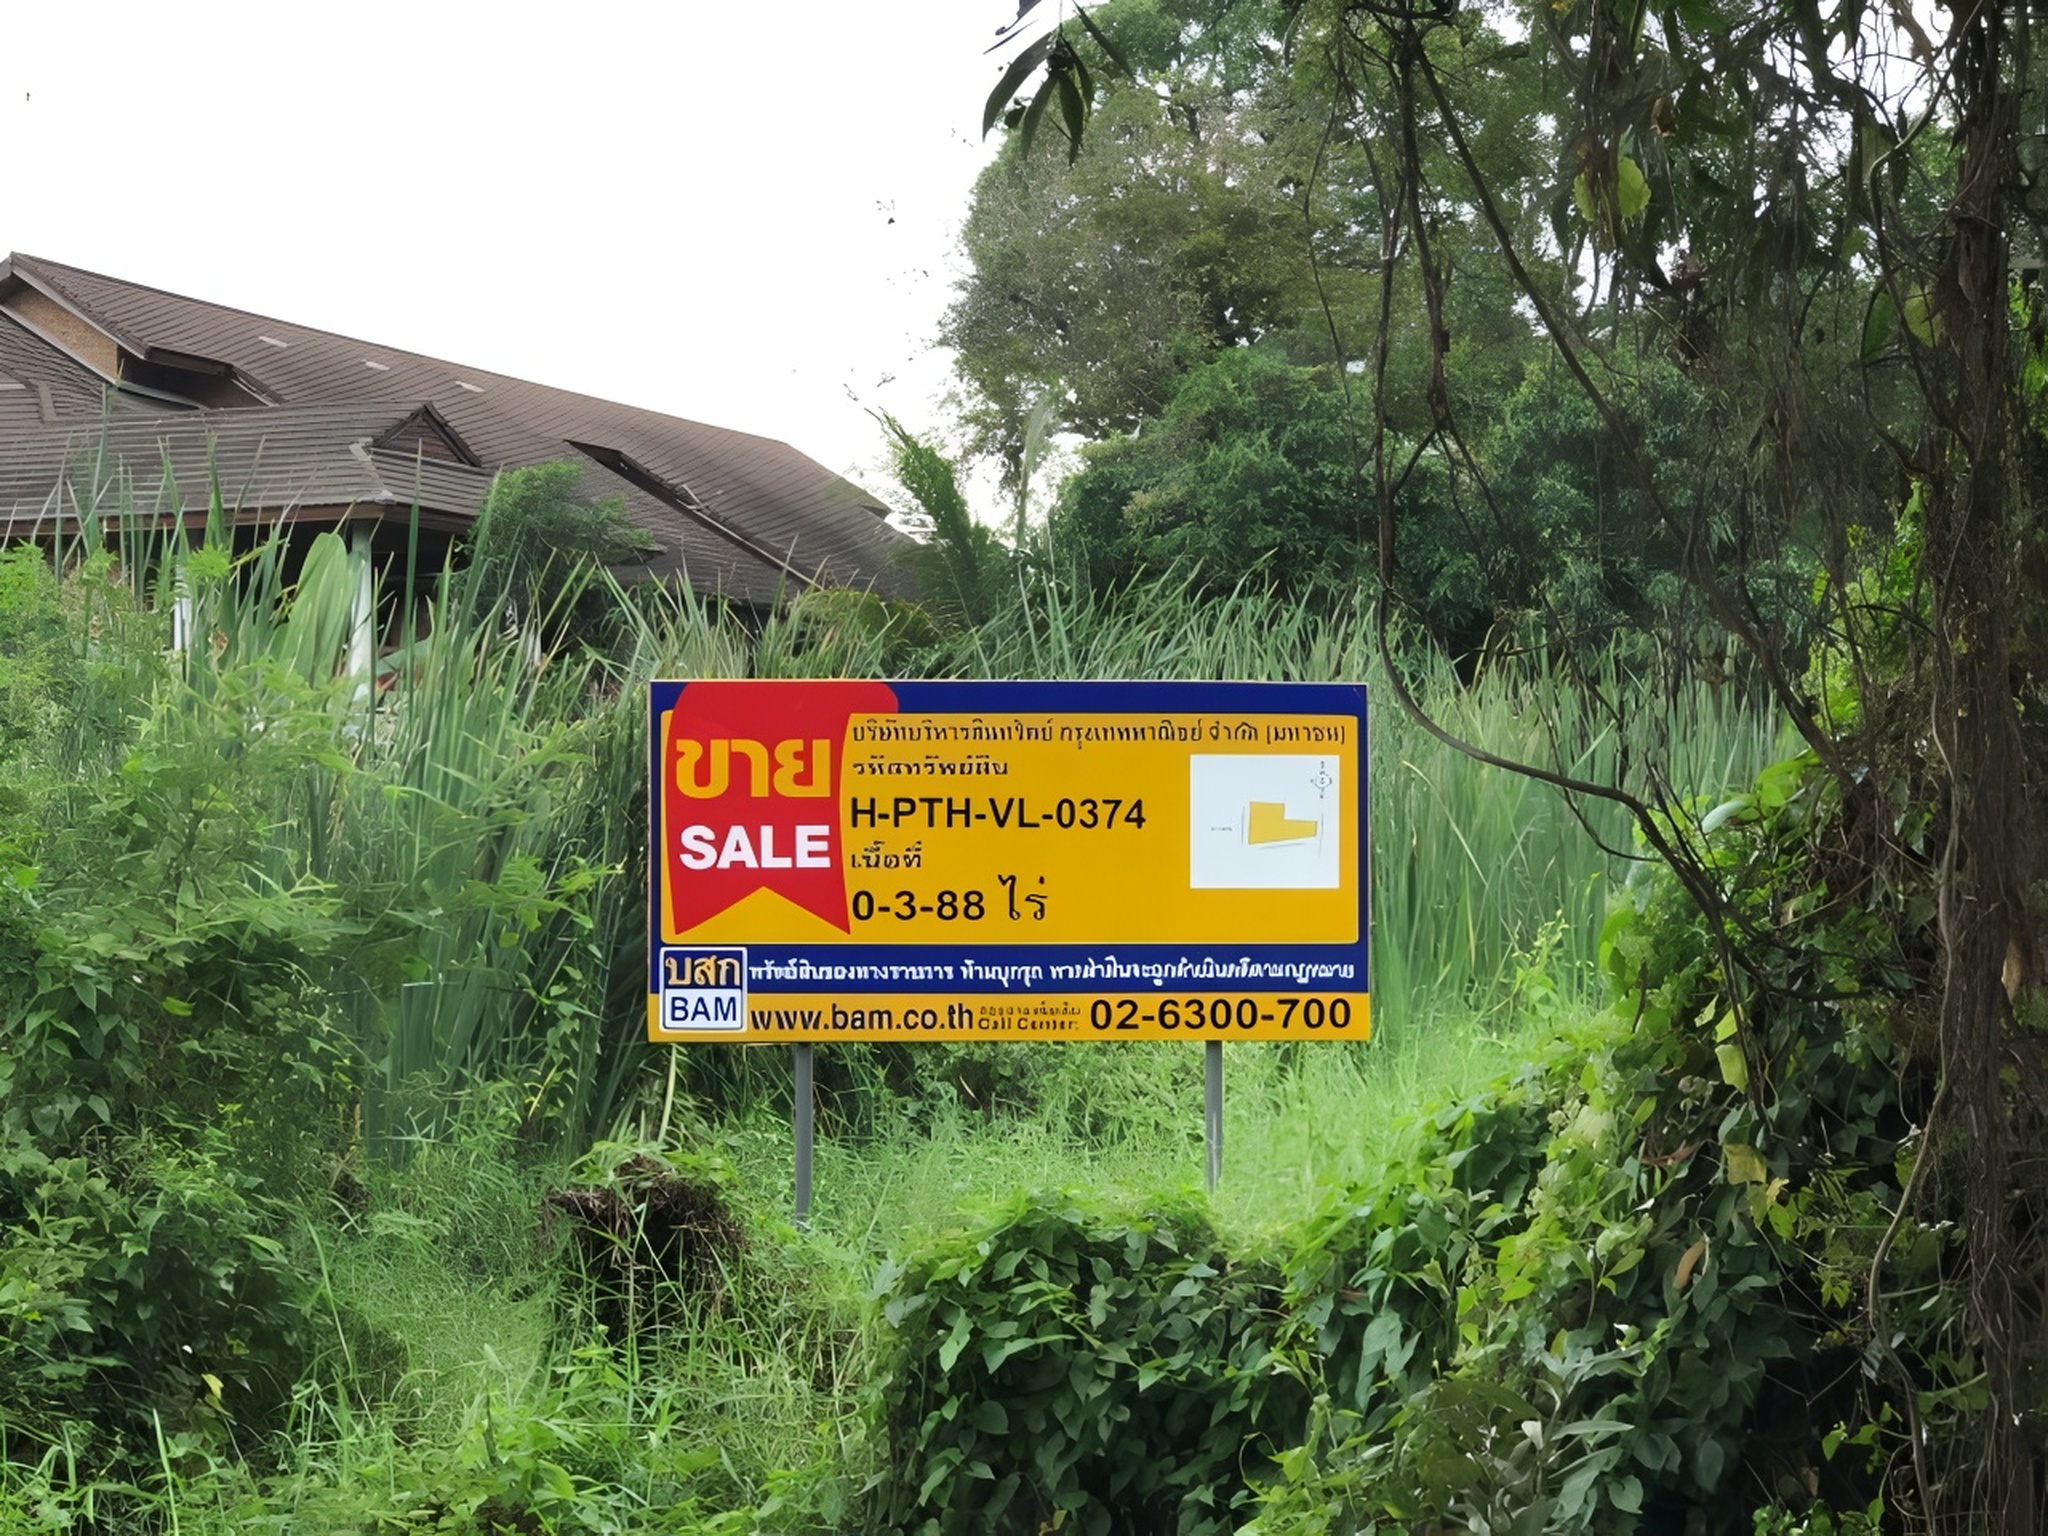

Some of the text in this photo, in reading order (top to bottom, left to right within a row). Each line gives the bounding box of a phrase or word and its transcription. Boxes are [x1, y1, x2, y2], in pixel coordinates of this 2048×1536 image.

[676, 738, 831, 799] ขาย
[850, 796, 1147, 830] H-PTH-VL-0374
[679, 824, 831, 870] SALE
[852, 874, 1048, 921] 0-3-88 ไร่
[664, 954, 741, 987] บสก
[670, 996, 737, 1023] BAM
[750, 1003, 973, 1031] www.bam.co.th
[1090, 998, 1351, 1030] 02-6300-700
